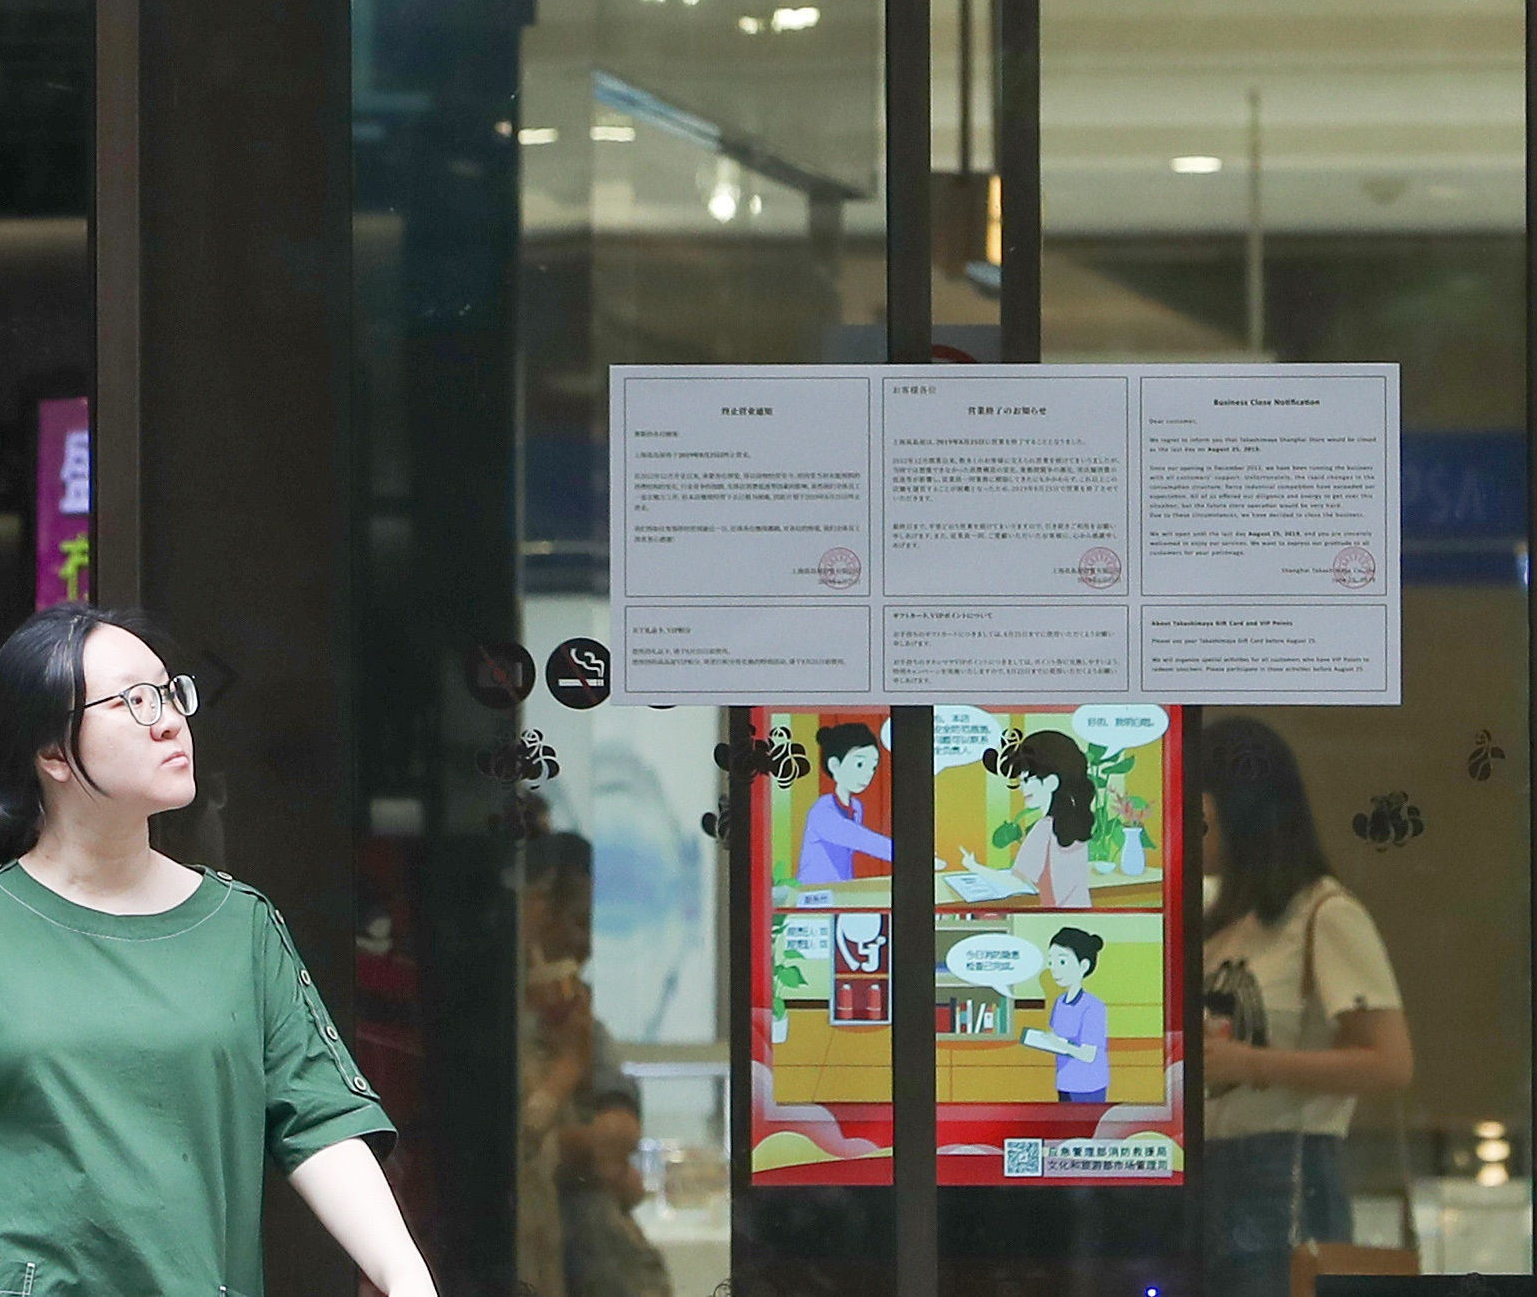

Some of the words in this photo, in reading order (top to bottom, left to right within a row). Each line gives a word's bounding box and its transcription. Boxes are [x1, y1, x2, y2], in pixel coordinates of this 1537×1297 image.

[967, 406, 1048, 416] 営業終了のお知らせ
